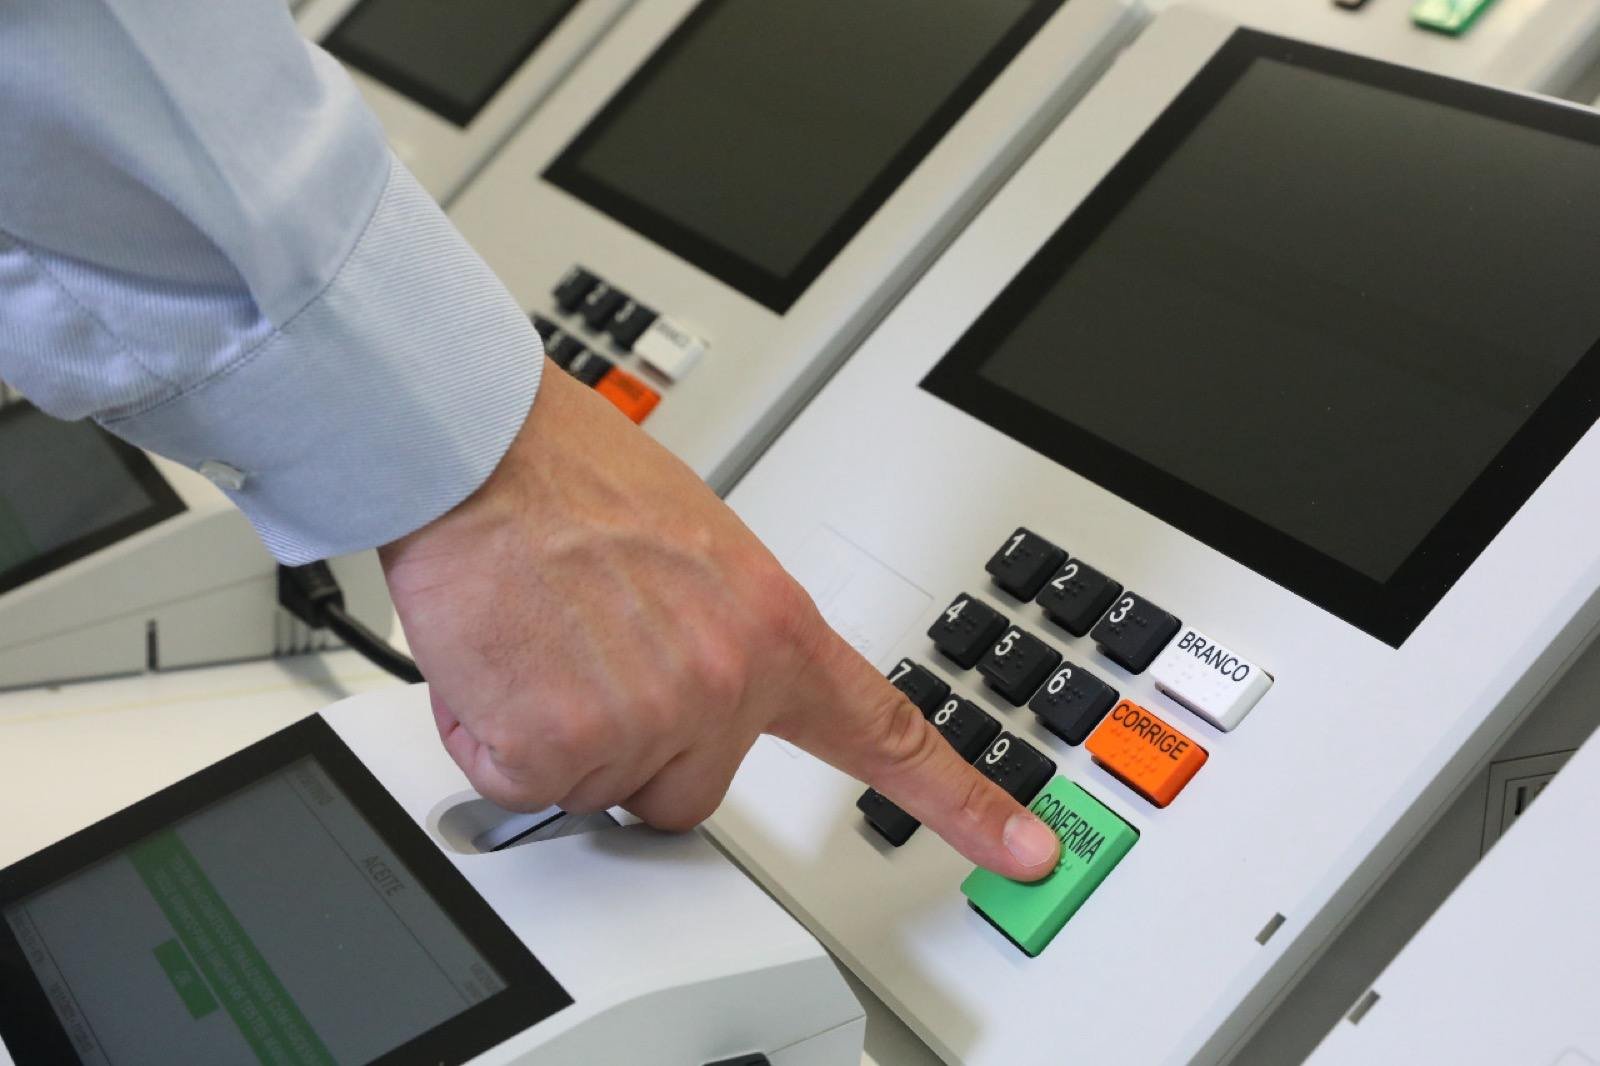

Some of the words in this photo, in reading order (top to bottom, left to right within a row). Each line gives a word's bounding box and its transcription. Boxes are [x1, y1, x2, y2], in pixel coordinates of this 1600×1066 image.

[1004, 533, 1026, 557] 1
[1051, 563, 1079, 590] 2
[946, 599, 969, 623] 4
[1109, 598, 1134, 623] 3
[994, 630, 1021, 656] 5
[1177, 630, 1250, 682] BRANCO
[889, 662, 912, 683] 7
[1047, 668, 1072, 694] 6
[934, 699, 958, 725] 8
[1111, 703, 1189, 761] CORRIGE
[985, 738, 1010, 764] 9
[1029, 793, 1106, 865] CONFIRMA
[363, 855, 406, 897] ACEITE
